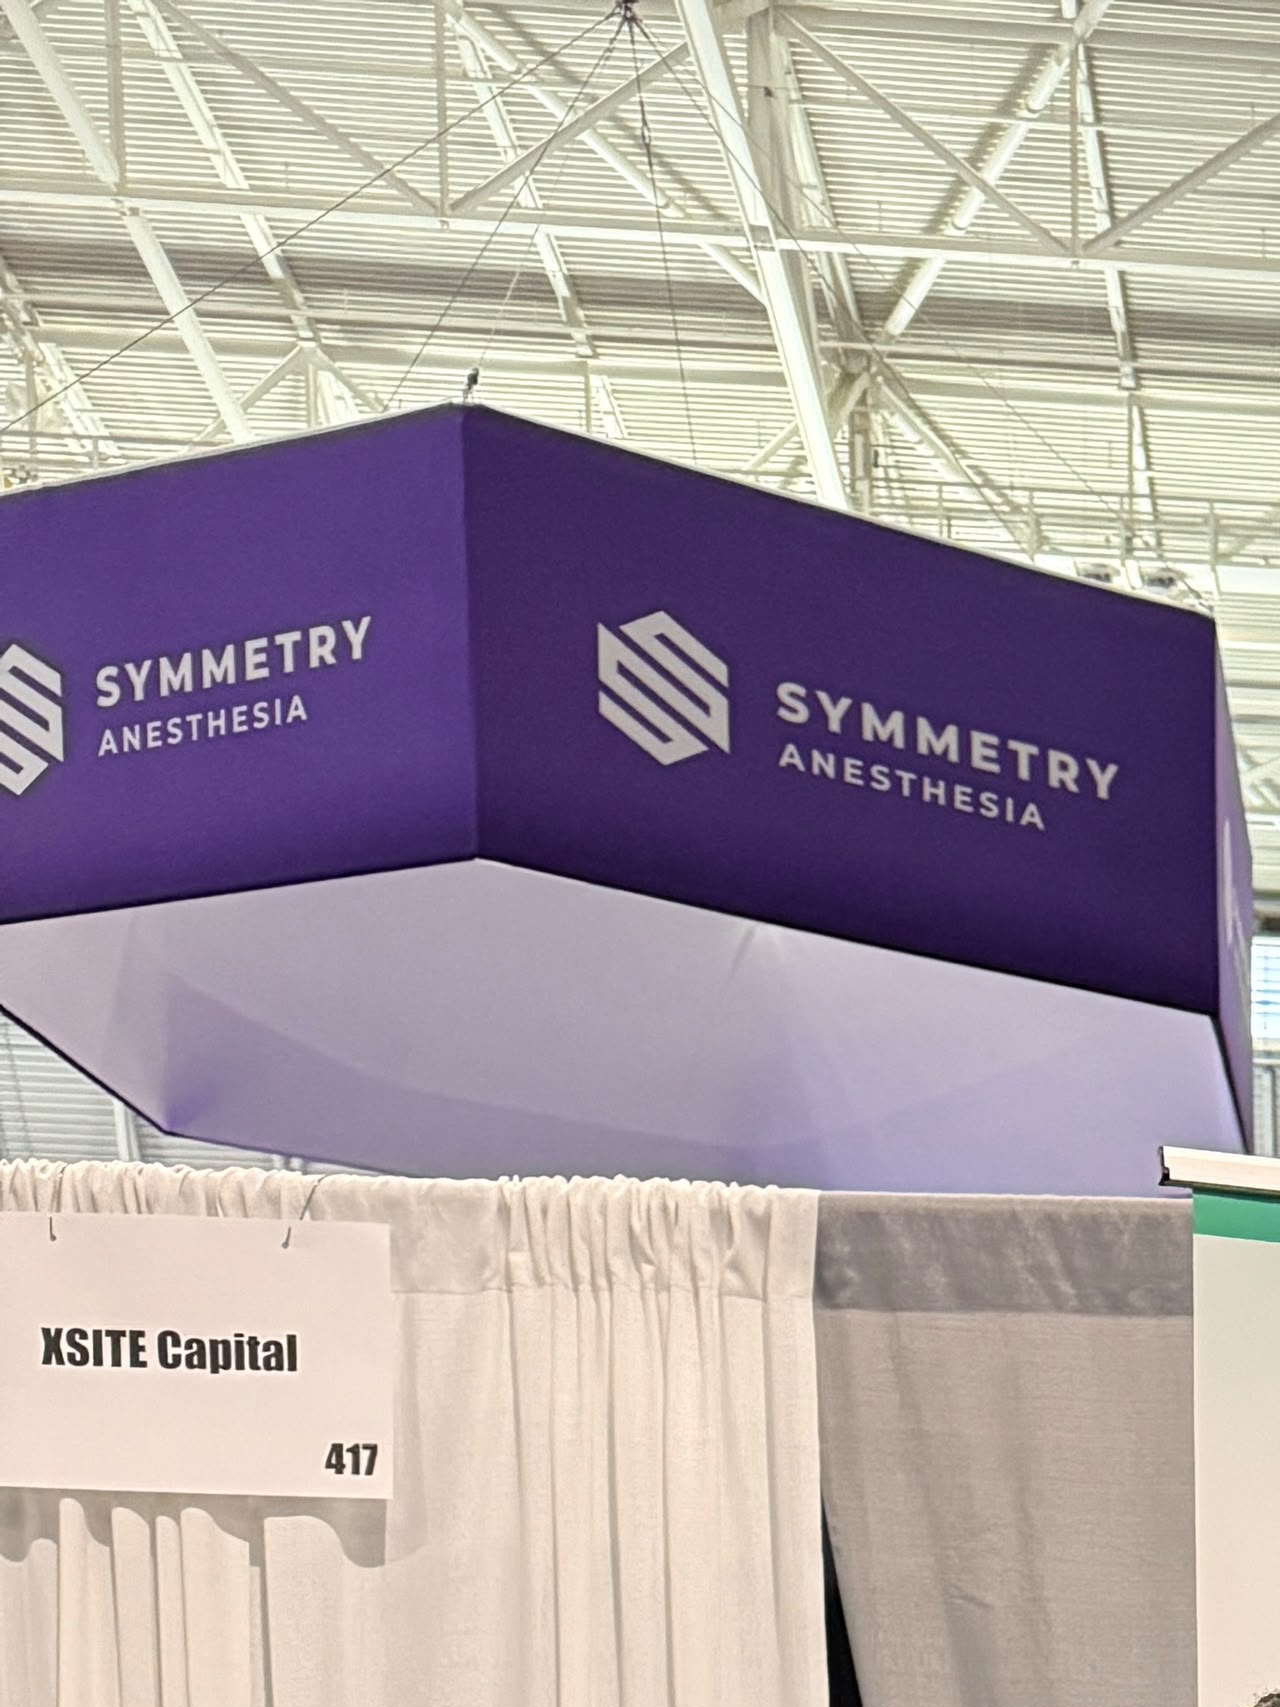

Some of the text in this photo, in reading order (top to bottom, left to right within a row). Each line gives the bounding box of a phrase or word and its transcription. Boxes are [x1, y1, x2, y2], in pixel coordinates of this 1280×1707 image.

[95, 615, 374, 707] SYMMETRY
[97, 695, 310, 757] ANESTHESIA
[775, 682, 1120, 800] SYMMETRY
[777, 742, 1047, 831] ANESTHESIA
[41, 1327, 298, 1374] XSITE Capital
[325, 1443, 379, 1475] 417
